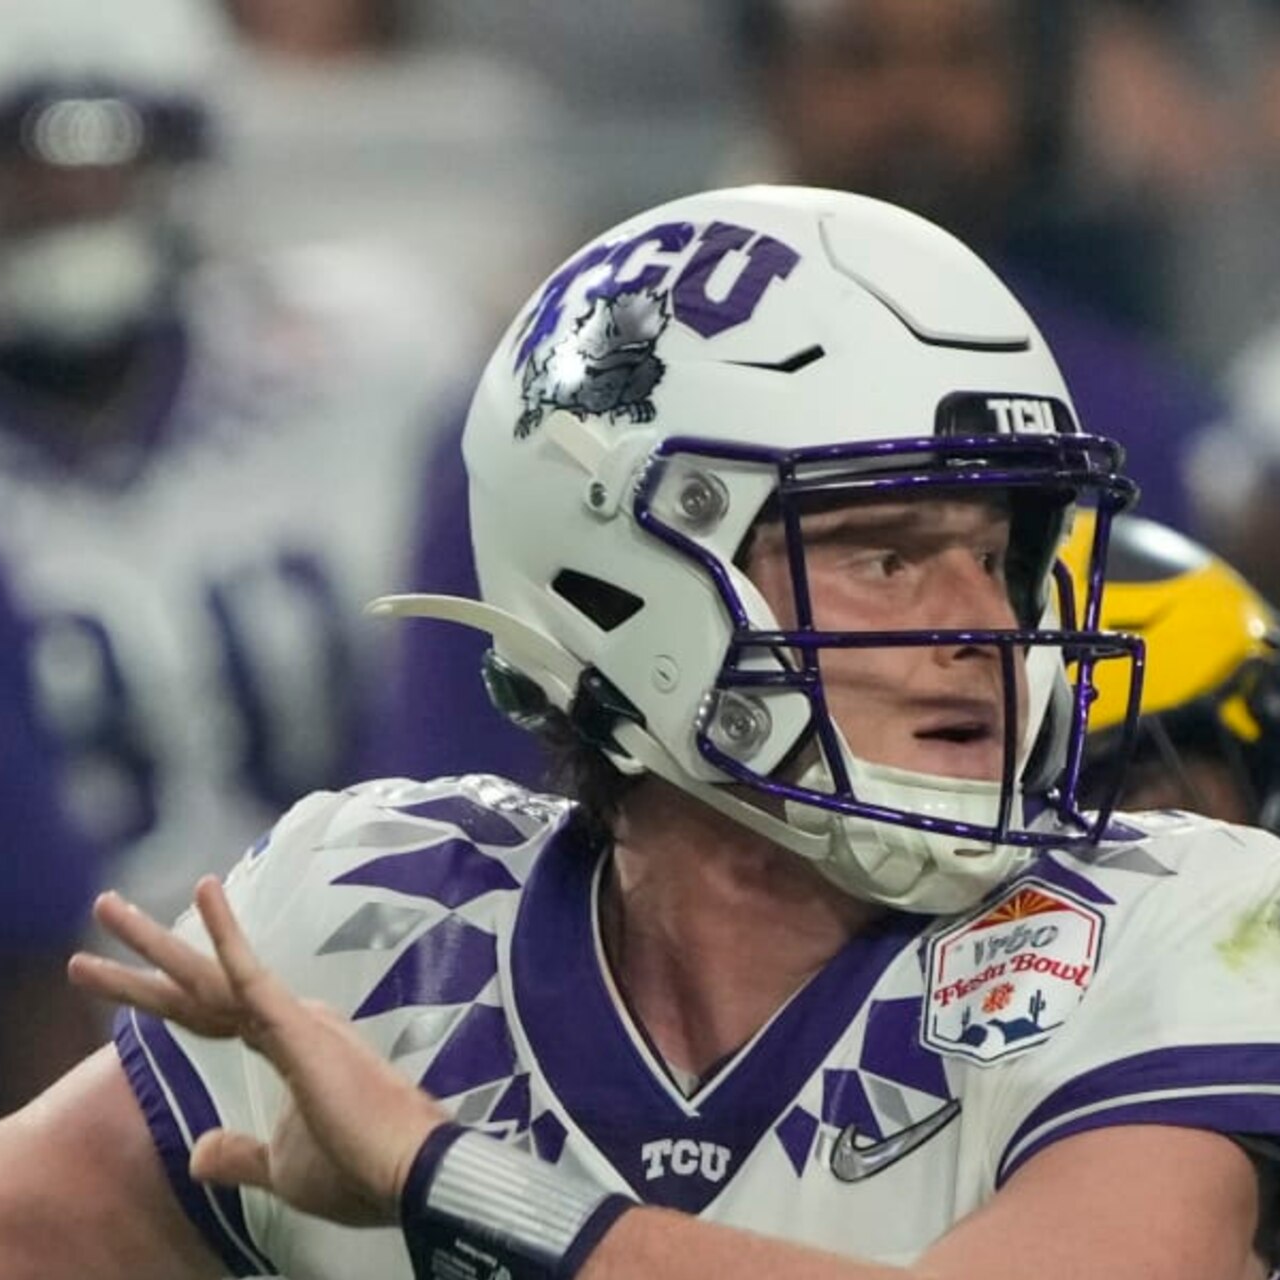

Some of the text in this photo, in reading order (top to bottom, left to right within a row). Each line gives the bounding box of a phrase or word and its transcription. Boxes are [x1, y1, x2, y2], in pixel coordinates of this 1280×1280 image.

[512, 219, 802, 376] TCU
[986, 398, 1062, 437] TCU
[933, 952, 1091, 1008] Fiesta Bowl
[641, 1137, 732, 1182] TCU
